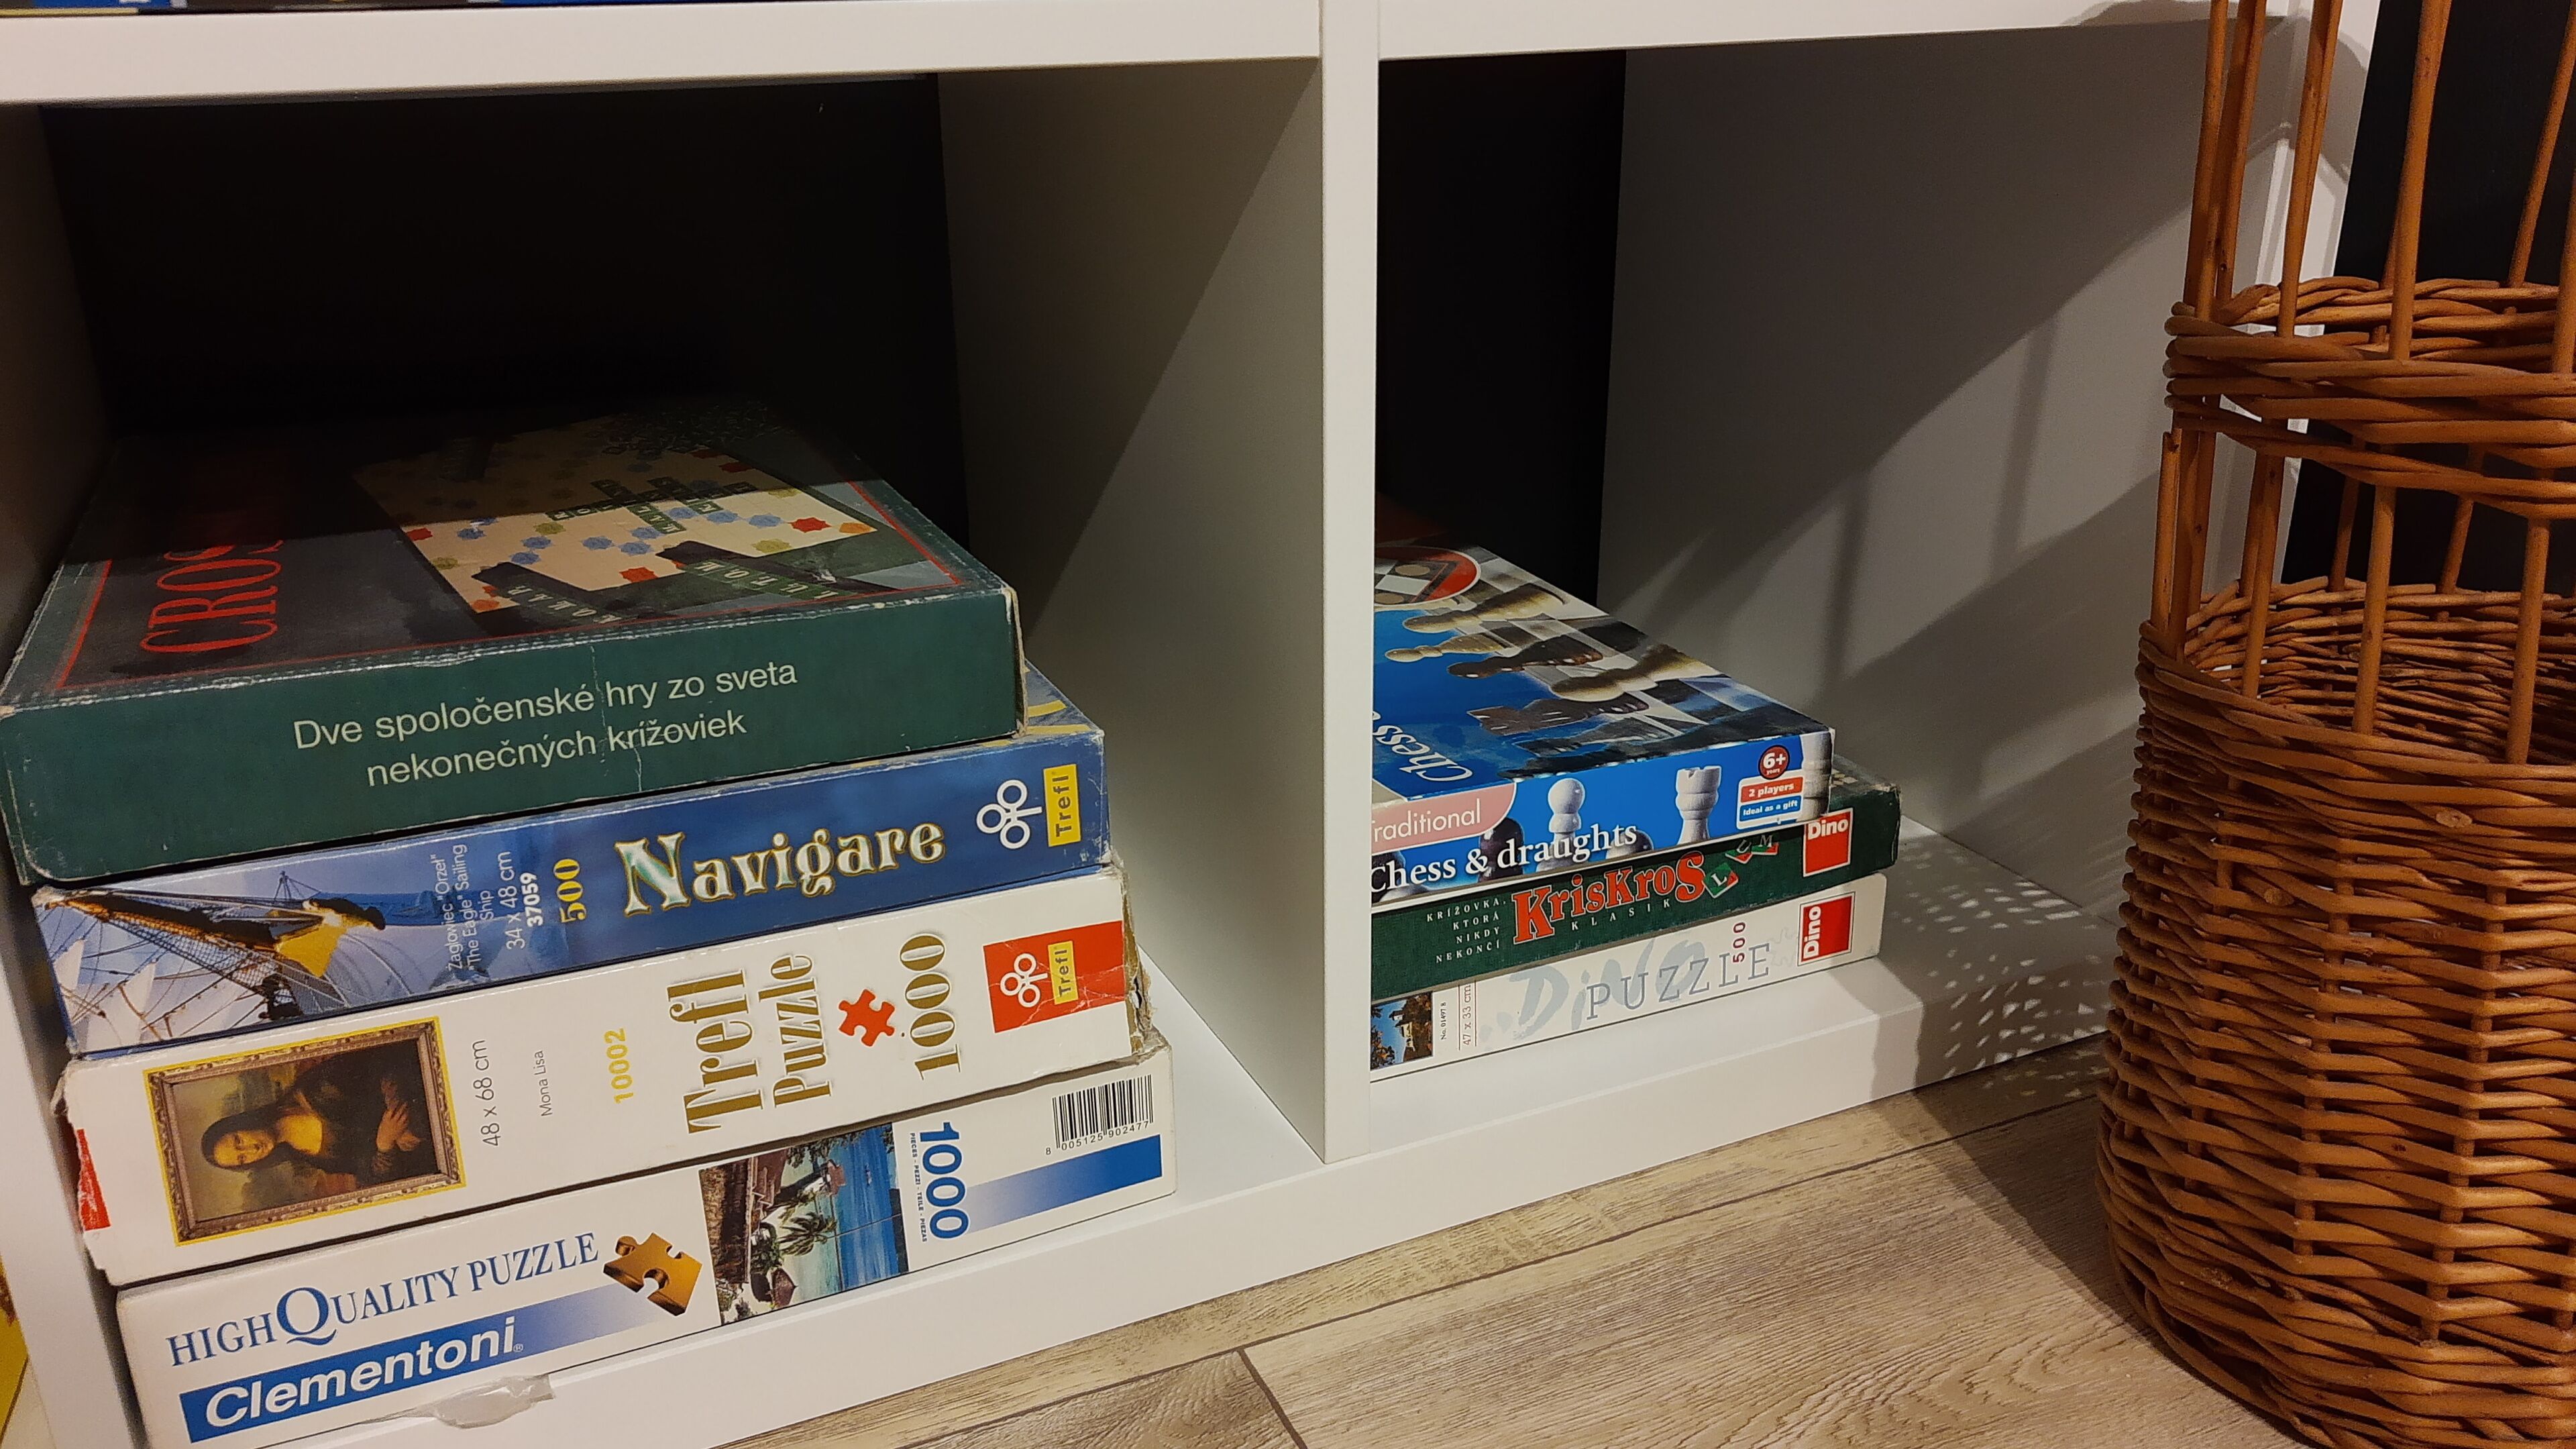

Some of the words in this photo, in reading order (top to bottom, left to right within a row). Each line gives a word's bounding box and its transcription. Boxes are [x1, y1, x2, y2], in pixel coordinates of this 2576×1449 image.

[294, 719, 363, 749] Dve
[376, 684, 594, 741] spoločenské
[606, 681, 658, 708] hry
[667, 676, 704, 699] zo
[716, 661, 798, 693] sveta
[367, 730, 596, 787] nekonečných
[608, 710, 747, 751] krížoviek
[1763, 753, 1786, 769] 6+
[1052, 775, 1072, 838] Trefl
[1743, 806, 1762, 816] Ideal
[1783, 800, 1798, 810] gift
[1749, 788, 1755, 798] 2
[1758, 783, 1794, 798] players
[1372, 798, 1481, 842] raditional
[1807, 818, 1849, 841] Dino
[451, 844, 469, 892] Sailing
[498, 851, 515, 881] cm
[614, 822, 946, 918] Navigare
[1371, 858, 1456, 892] Chess
[1465, 848, 1489, 874] &
[1497, 823, 1637, 869] draughts
[478, 890, 494, 920] Ship
[498, 885, 517, 908] 48
[520, 872, 543, 927] 37059
[553, 858, 587, 924] 500
[508, 912, 522, 923] x
[1453, 911, 1499, 931] KTORÁ
[1572, 898, 1670, 931] KLASIK
[1803, 906, 1821, 959] Dino
[505, 928, 525, 949] 34
[1456, 926, 1500, 945] NIKDY
[1733, 922, 1746, 963] 500
[1055, 950, 1071, 998] Trefl
[1586, 943, 1771, 1020] PUZZLE
[900, 934, 960, 1080] 1000
[759, 955, 832, 1108] Puzzle
[472, 1040, 489, 1071] cm
[533, 1050, 546, 1075] Lisa
[604, 1028, 634, 1104] 10002
[667, 969, 763, 1134] Trefl
[473, 1077, 494, 1101] 68
[539, 1079, 553, 1116] Mona
[483, 1106, 497, 1118] x
[481, 1123, 501, 1146] 48
[910, 1133, 918, 1158] PIECES
[1046, 1147, 1051, 1155] 8
[1061, 1133, 1103, 1150] 005125
[1108, 1121, 1148, 1138] 902477
[920, 1122, 969, 1238] 1000
[166, 1312, 277, 1366] HIGH
[467, 1232, 599, 1292] PUZZLE
